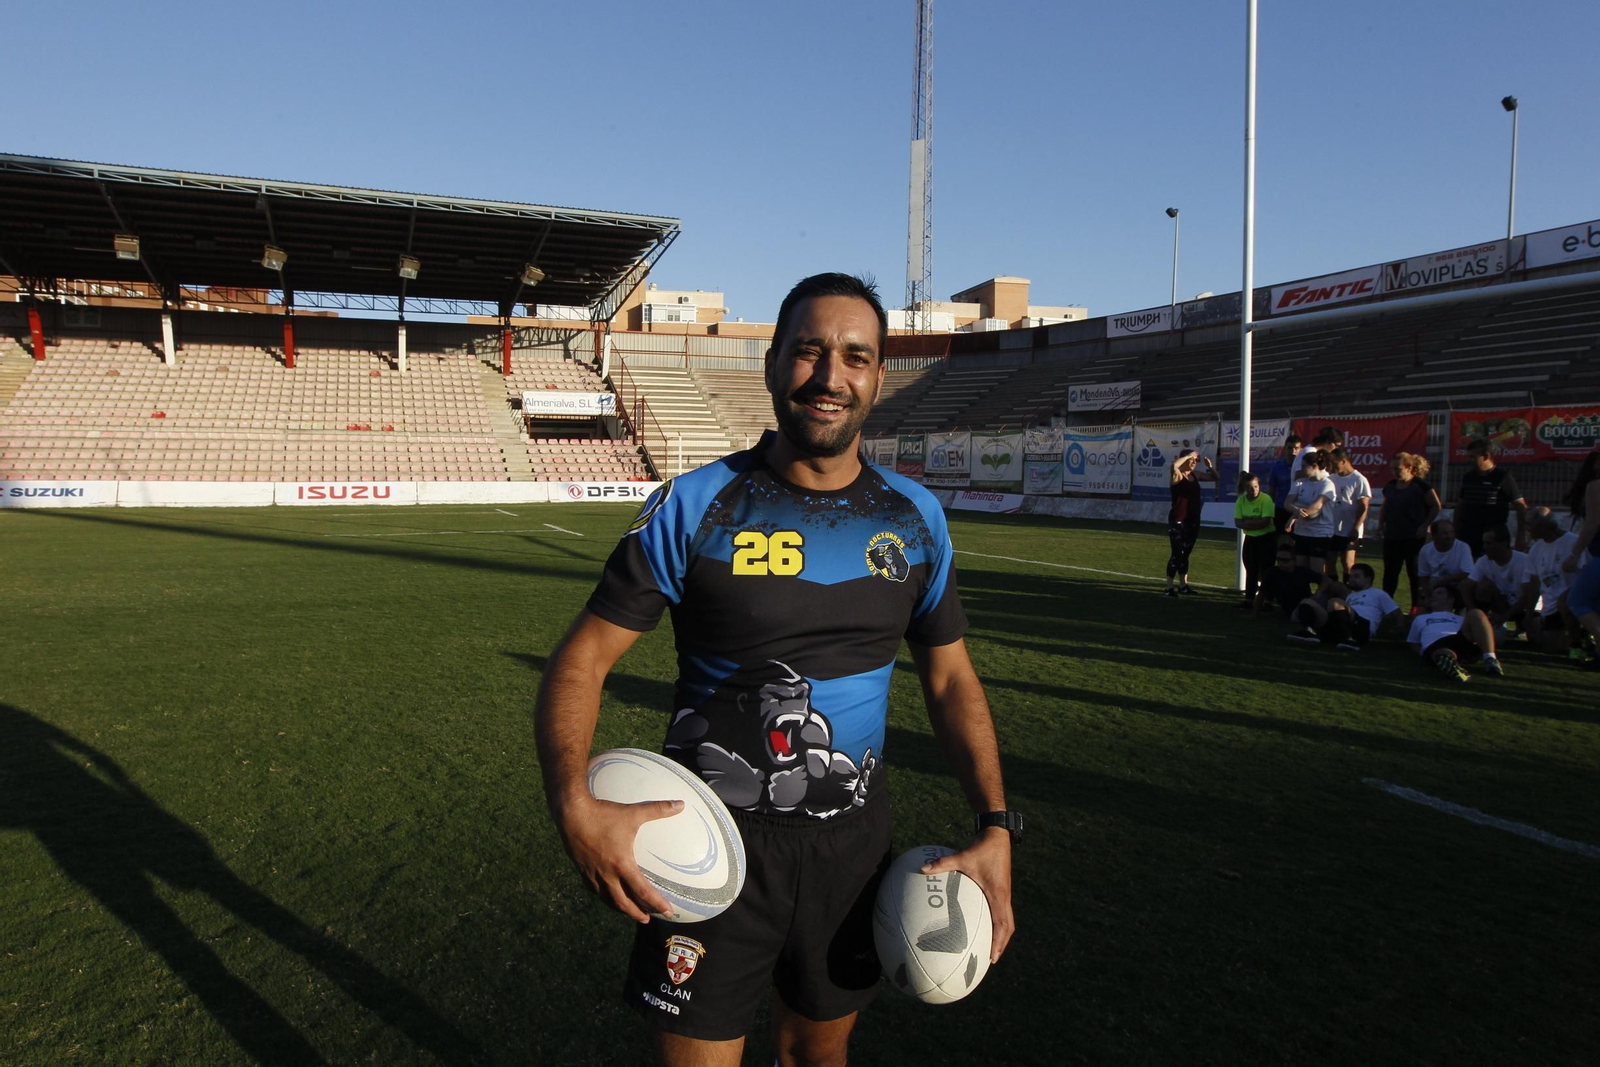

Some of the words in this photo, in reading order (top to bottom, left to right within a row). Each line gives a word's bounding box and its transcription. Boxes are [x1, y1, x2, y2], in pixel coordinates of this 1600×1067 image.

[1385, 257, 1489, 292] MOVIPLAS
[1276, 278, 1375, 309] FANTIC
[1113, 312, 1161, 332] TRIUMPH
[1343, 431, 1382, 448] laza
[1544, 425, 1600, 438] BOUQUE
[9, 487, 84, 497] SUZUKI
[298, 486, 390, 499] ISUZU
[587, 486, 646, 497] DFSK
[732, 530, 804, 576] 26
[660, 983, 692, 1002] CLAN
